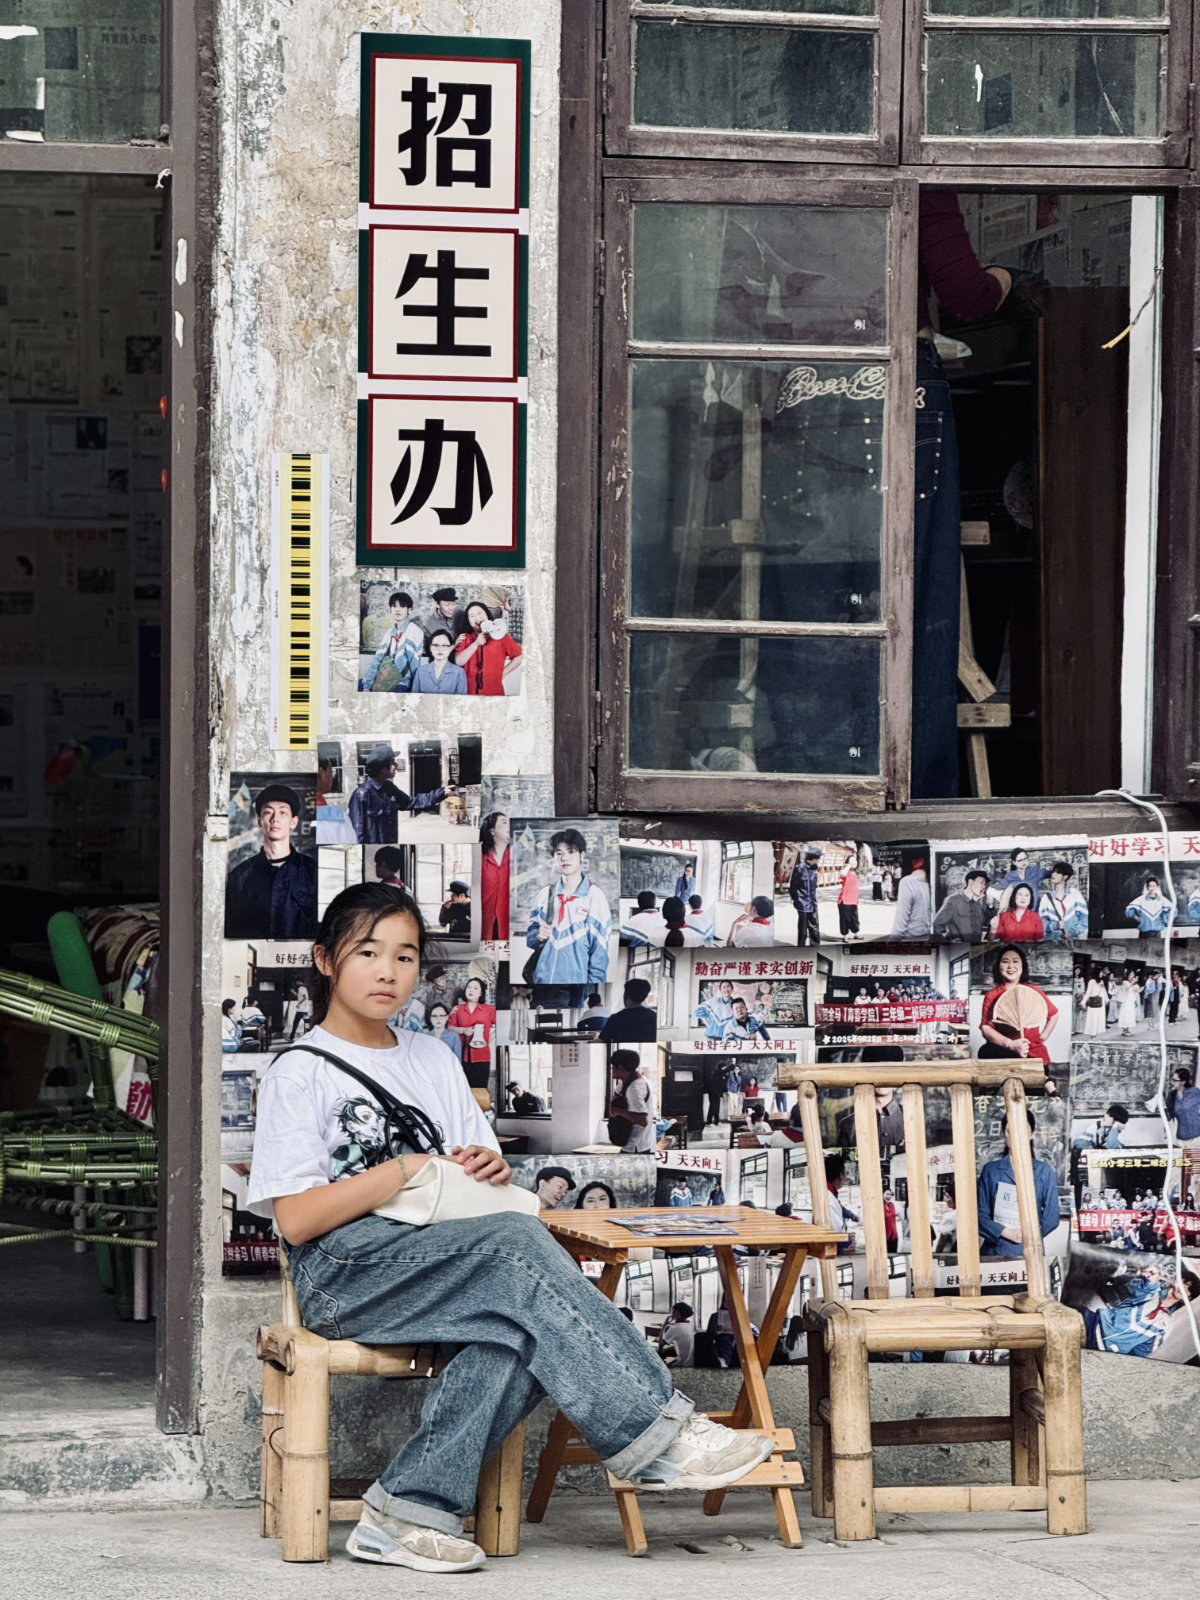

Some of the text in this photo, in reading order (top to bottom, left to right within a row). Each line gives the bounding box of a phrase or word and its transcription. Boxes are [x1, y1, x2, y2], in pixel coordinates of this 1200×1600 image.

[390, 76, 494, 526] 招生办
[694, 960, 814, 976] 勤奋严谨 求实创新
[850, 964, 931, 974] 好好学习 天天向上
[677, 1153, 722, 1171] 天天向上
